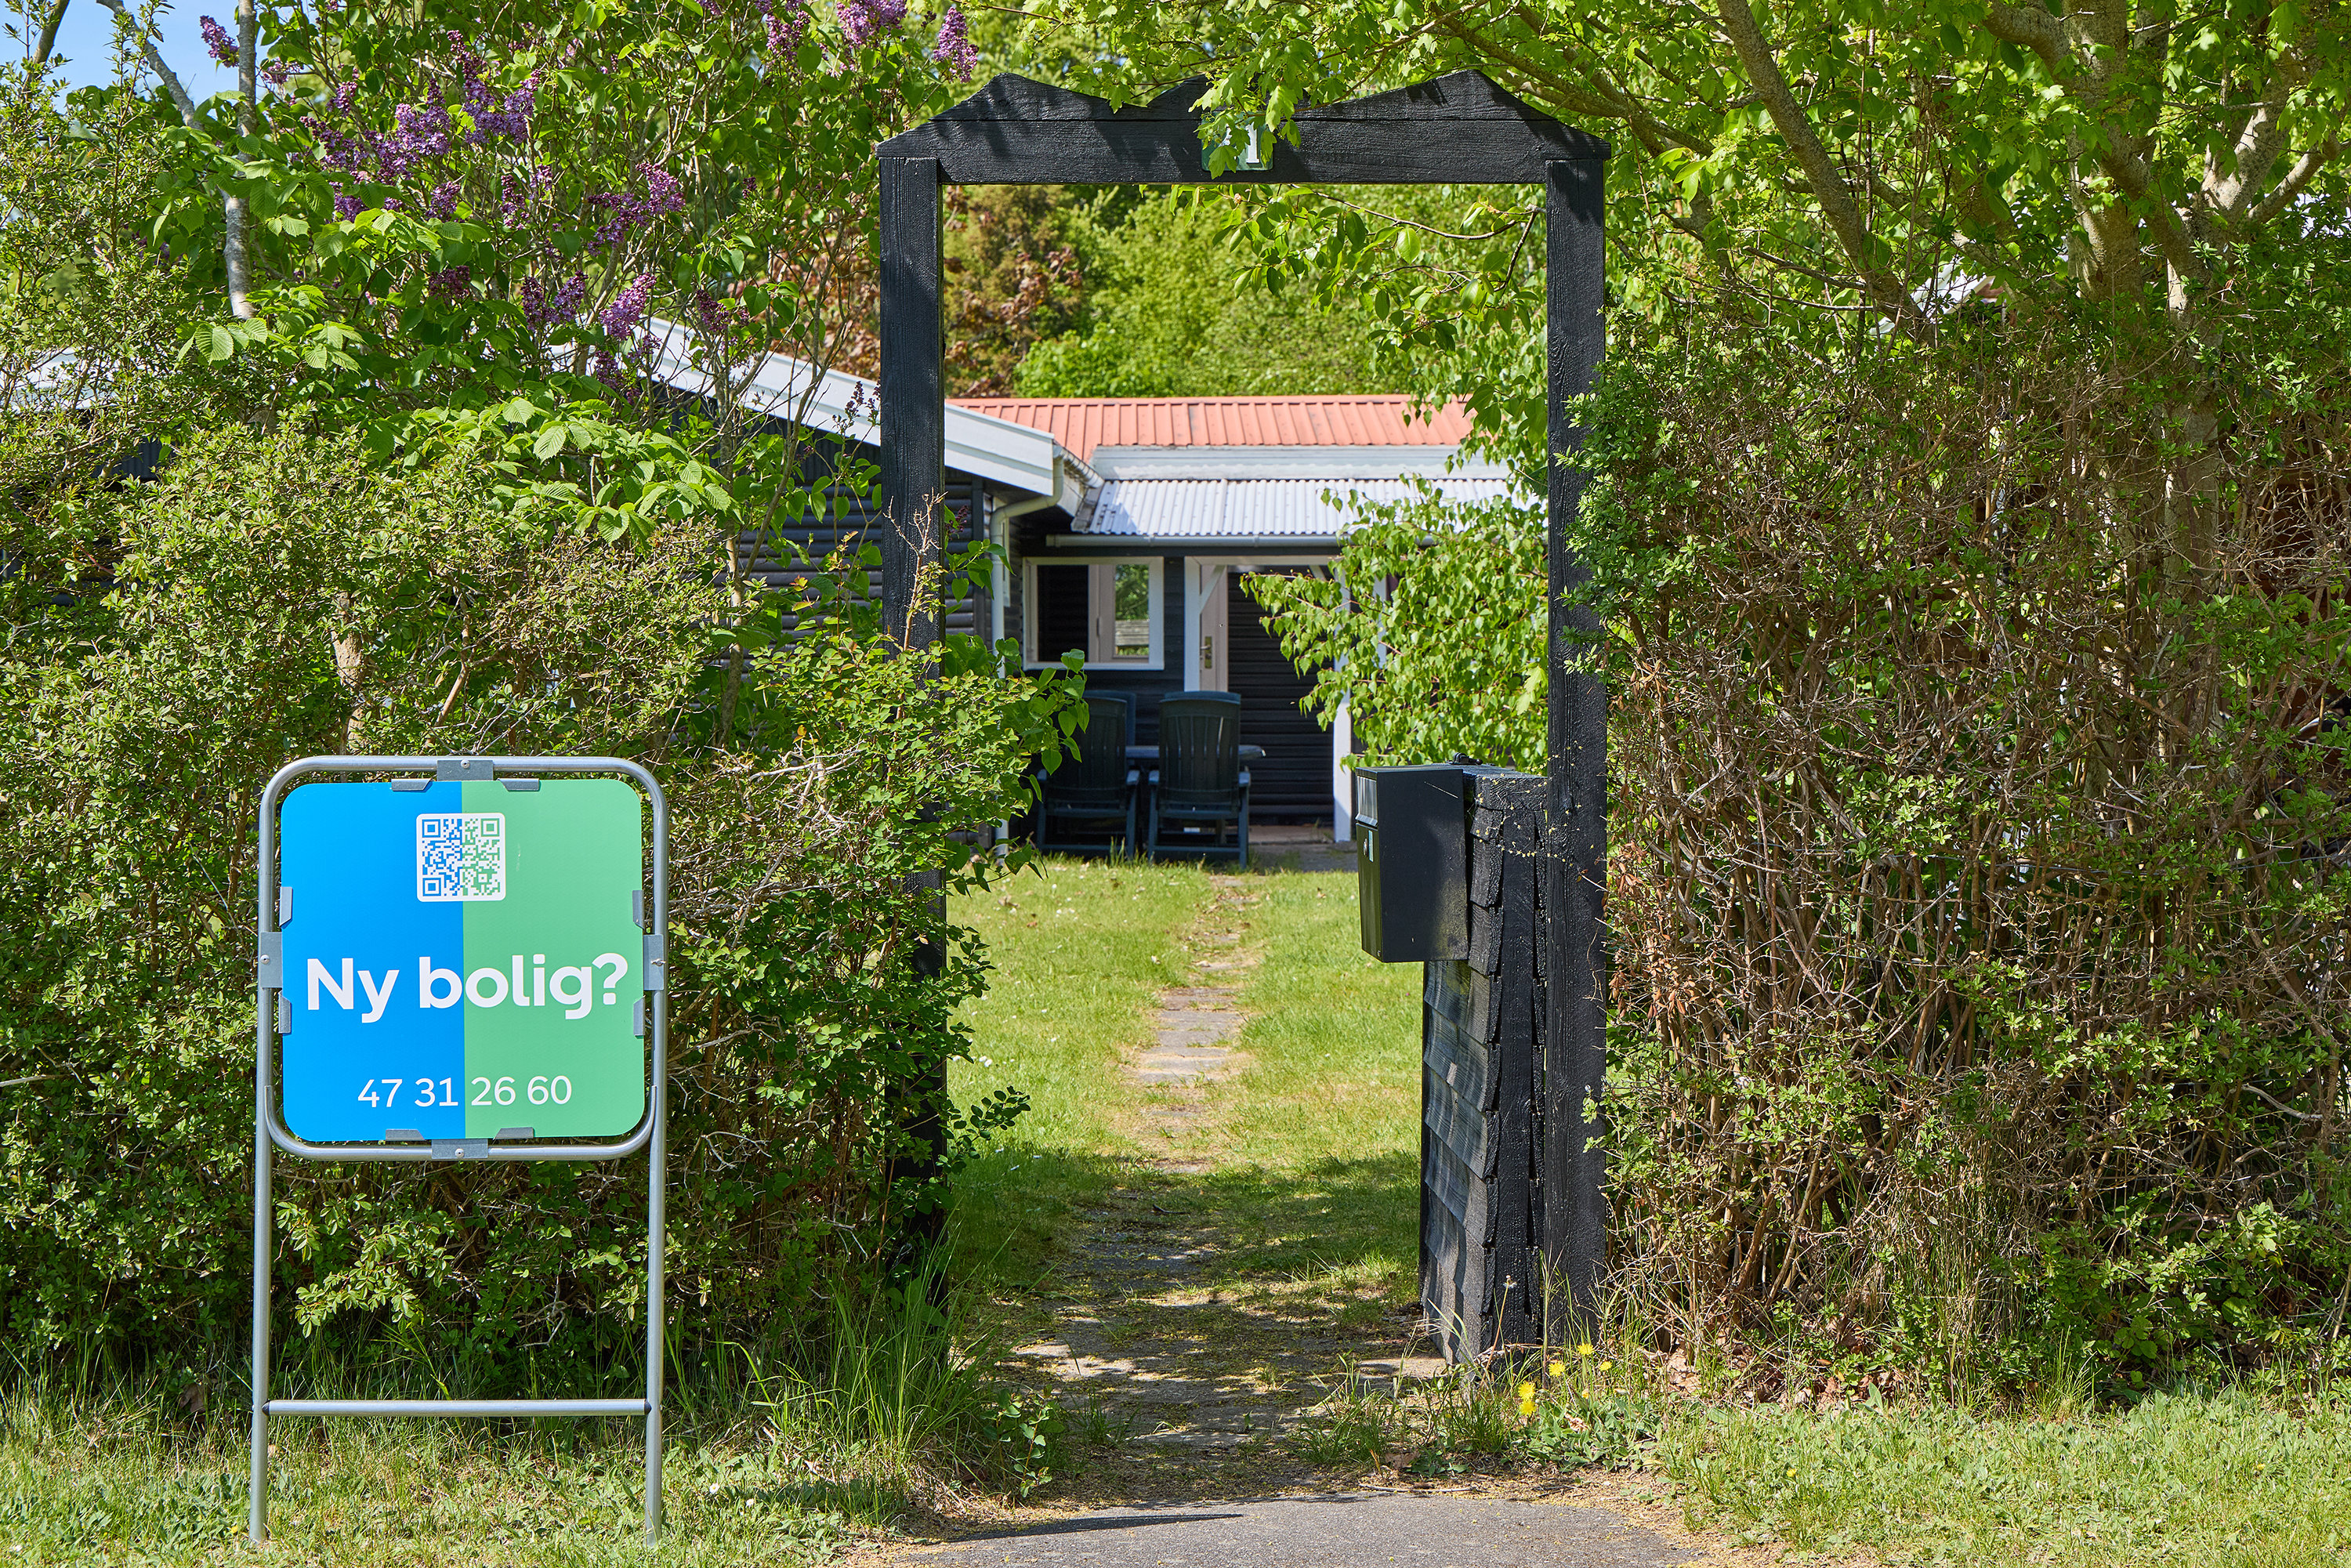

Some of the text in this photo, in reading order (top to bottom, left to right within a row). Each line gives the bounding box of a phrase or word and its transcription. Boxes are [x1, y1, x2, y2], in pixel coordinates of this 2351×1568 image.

[307, 952, 629, 1023] Ny bolig?
[357, 1075, 572, 1108] 47 31 26 60
